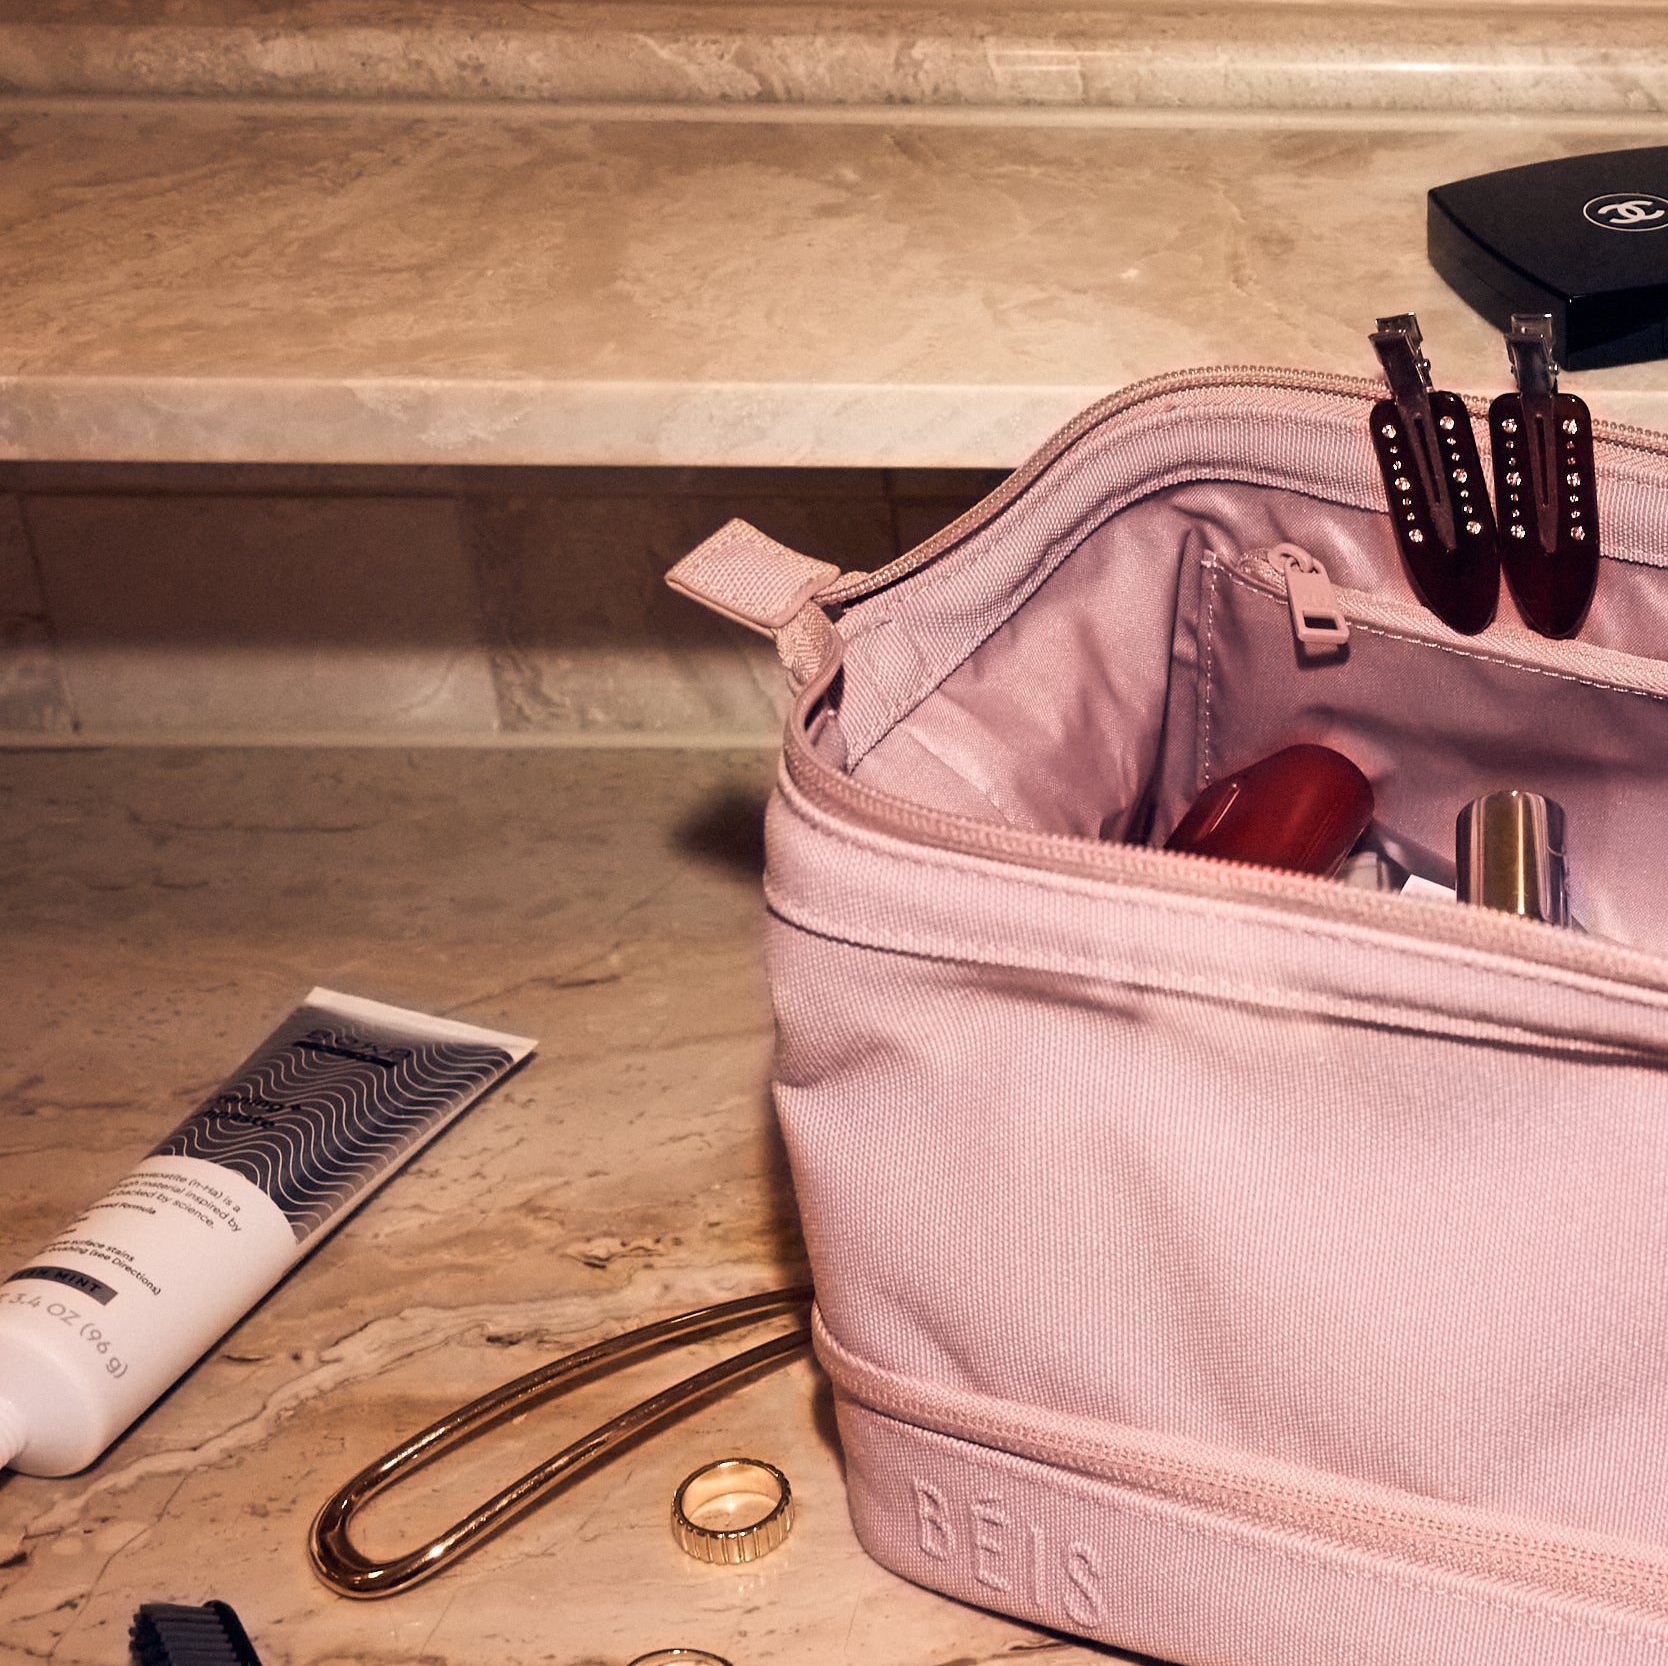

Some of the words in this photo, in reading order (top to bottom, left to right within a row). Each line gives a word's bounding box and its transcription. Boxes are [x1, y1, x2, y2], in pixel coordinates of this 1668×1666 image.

[156, 1193, 172, 1203] by
[172, 1199, 214, 1229] science.
[185, 1190, 230, 1220] inspired
[227, 1217, 242, 1232] by
[223, 1195, 233, 1206] is
[232, 1204, 241, 1213] a
[105, 1244, 135, 1262] stains
[54, 1272, 102, 1292] MINT
[89, 1249, 111, 1261] (see
[111, 1257, 162, 1296] Directions)
[46, 1303, 81, 1326] OZ
[80, 1322, 111, 1354] (96
[105, 1357, 128, 1379] g)
